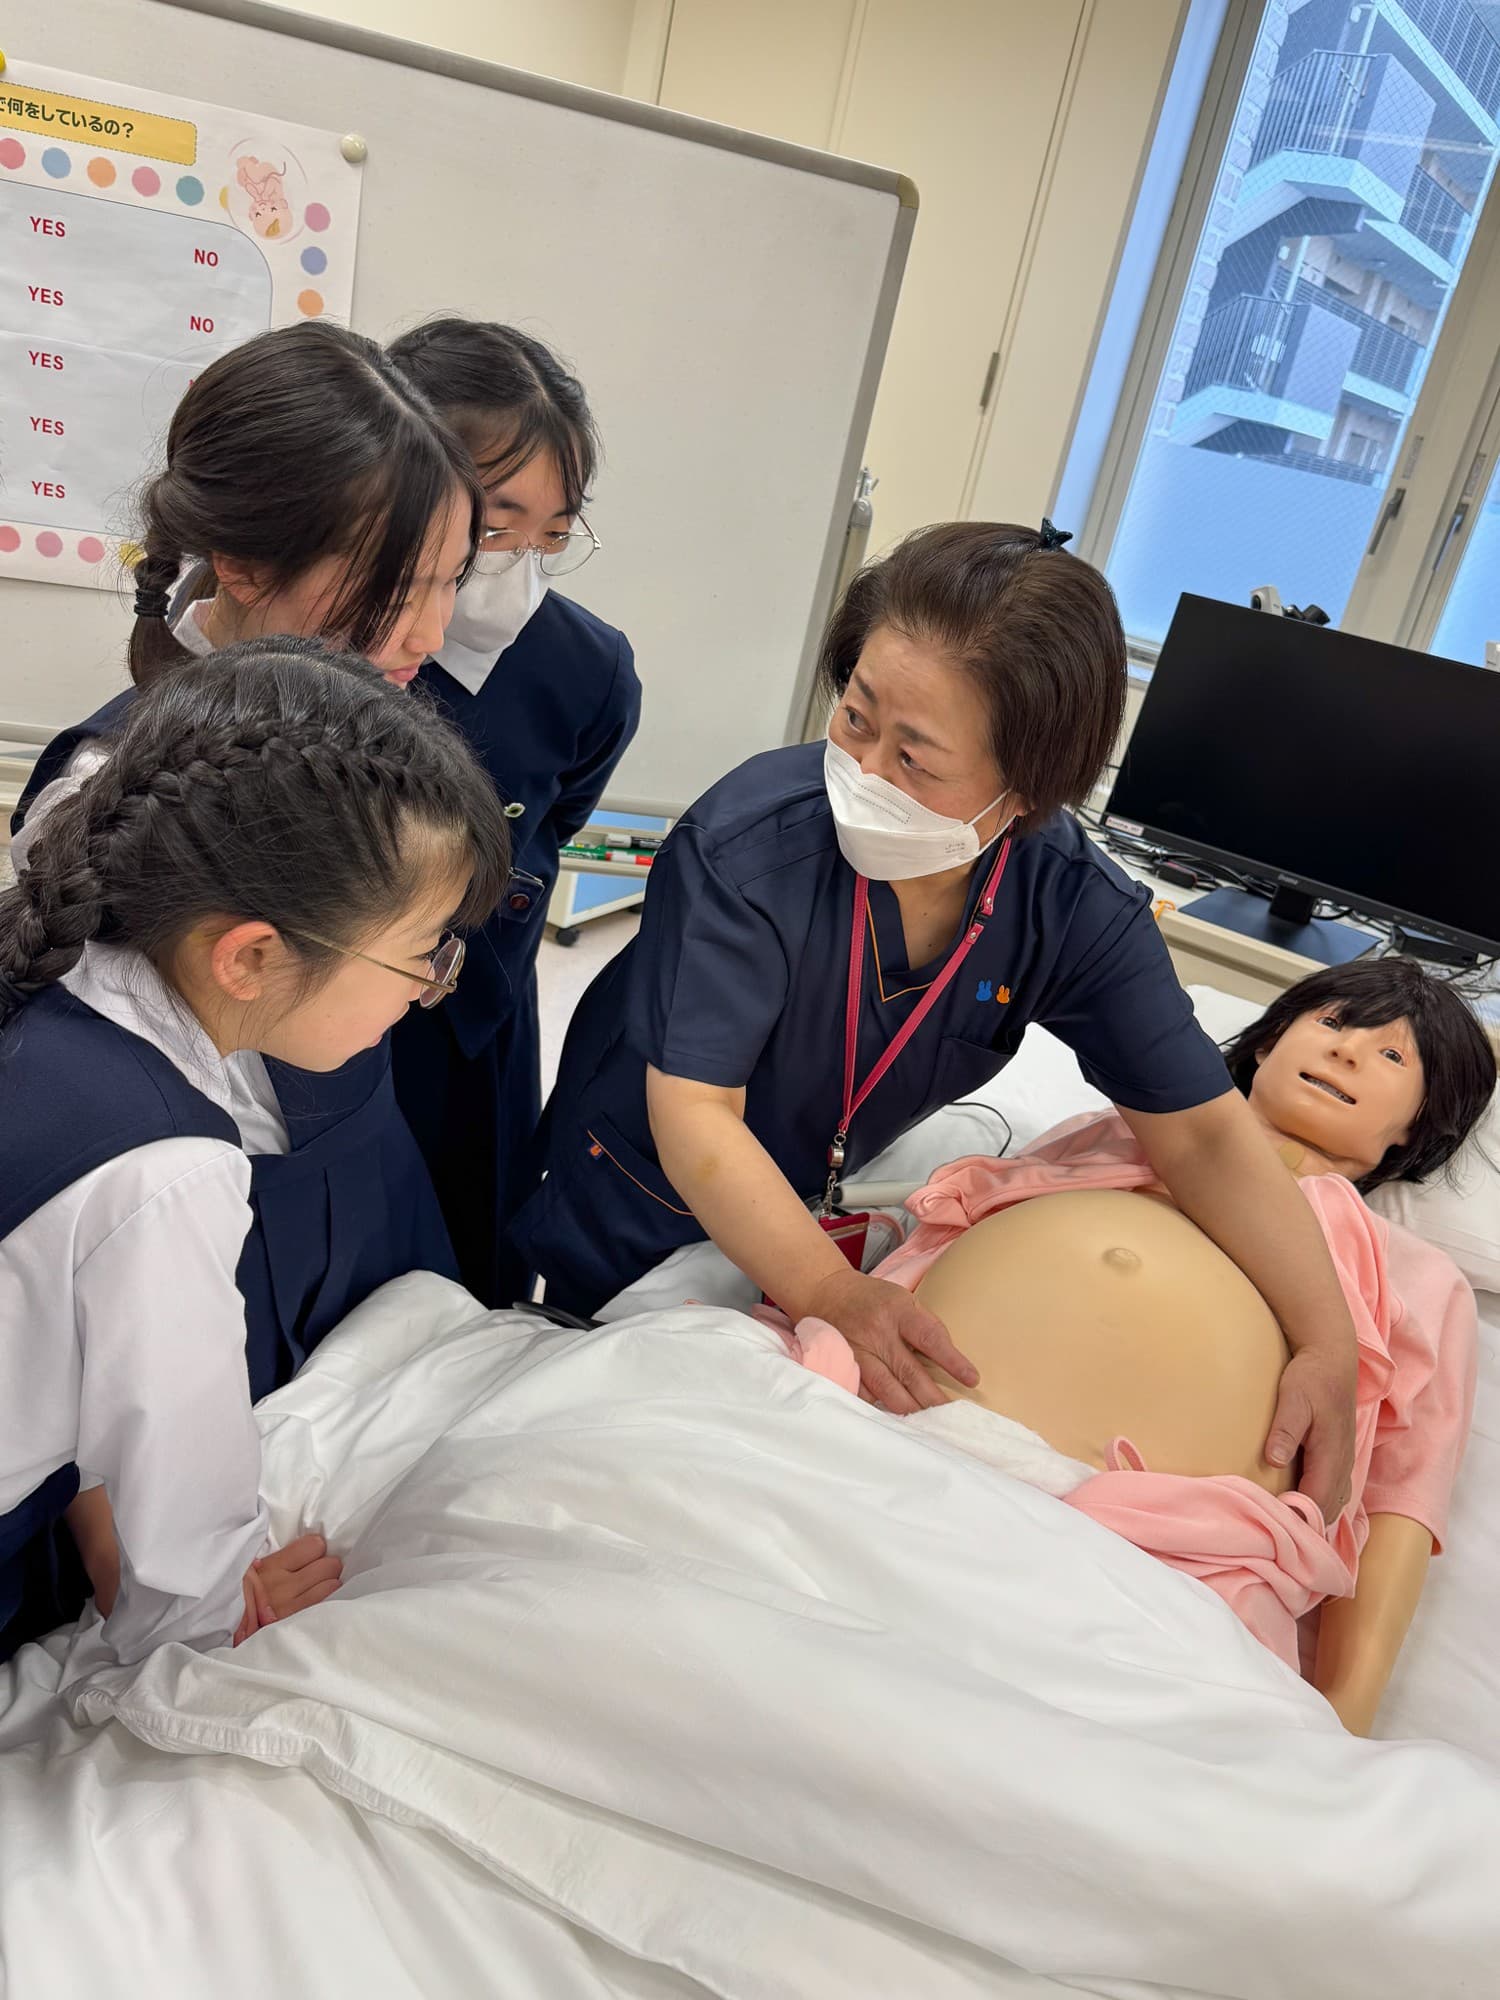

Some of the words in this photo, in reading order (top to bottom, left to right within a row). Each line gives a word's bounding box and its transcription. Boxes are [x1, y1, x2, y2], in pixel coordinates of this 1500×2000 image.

[29, 216, 66, 238] YES
[193, 248, 219, 268] NO
[28, 286, 64, 307] YES
[189, 315, 215, 334] NO
[28, 350, 64, 371] YES
[30, 416, 65, 436] YES
[31, 481, 66, 500] YES
